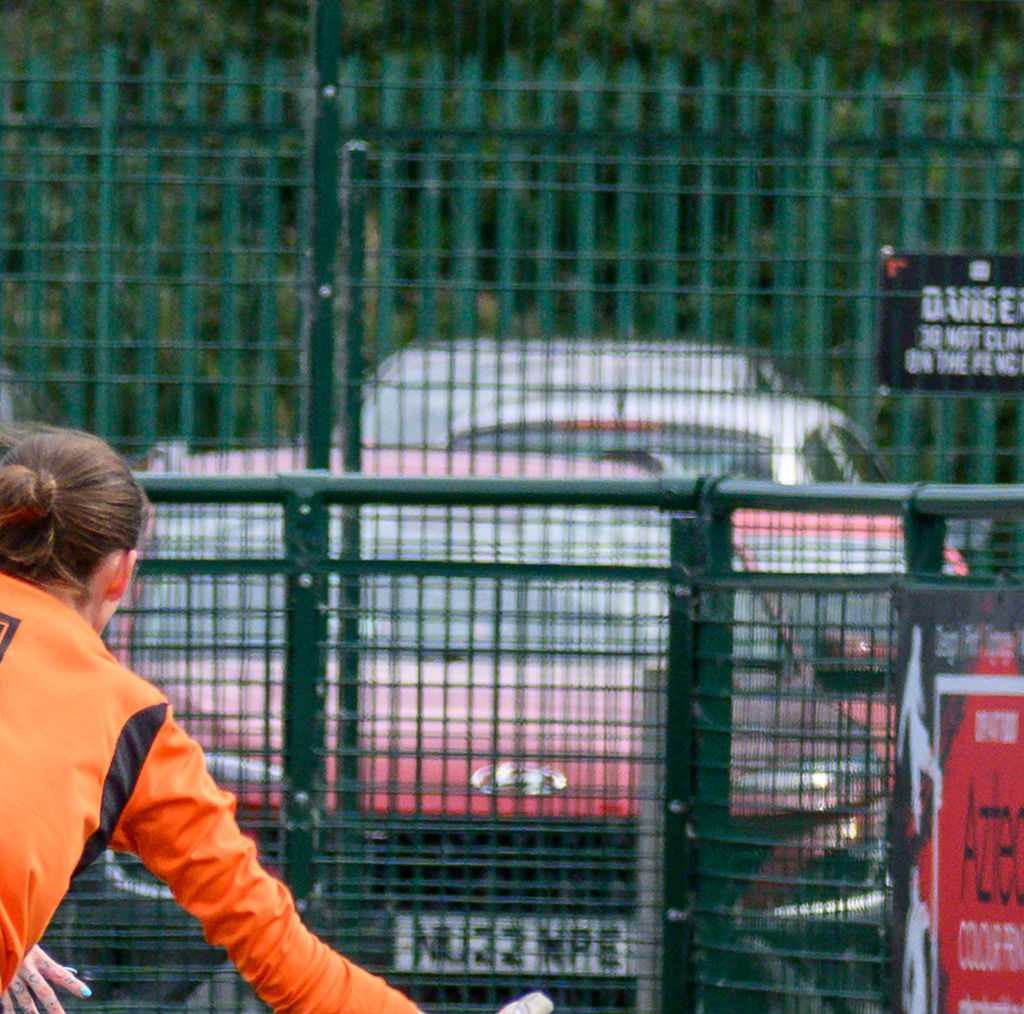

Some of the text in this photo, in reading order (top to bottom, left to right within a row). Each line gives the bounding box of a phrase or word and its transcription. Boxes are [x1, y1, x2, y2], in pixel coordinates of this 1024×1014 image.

[922, 287, 1024, 323] DANGE
[946, 326, 982, 349] NOT
[973, 351, 1024, 376] FENC
